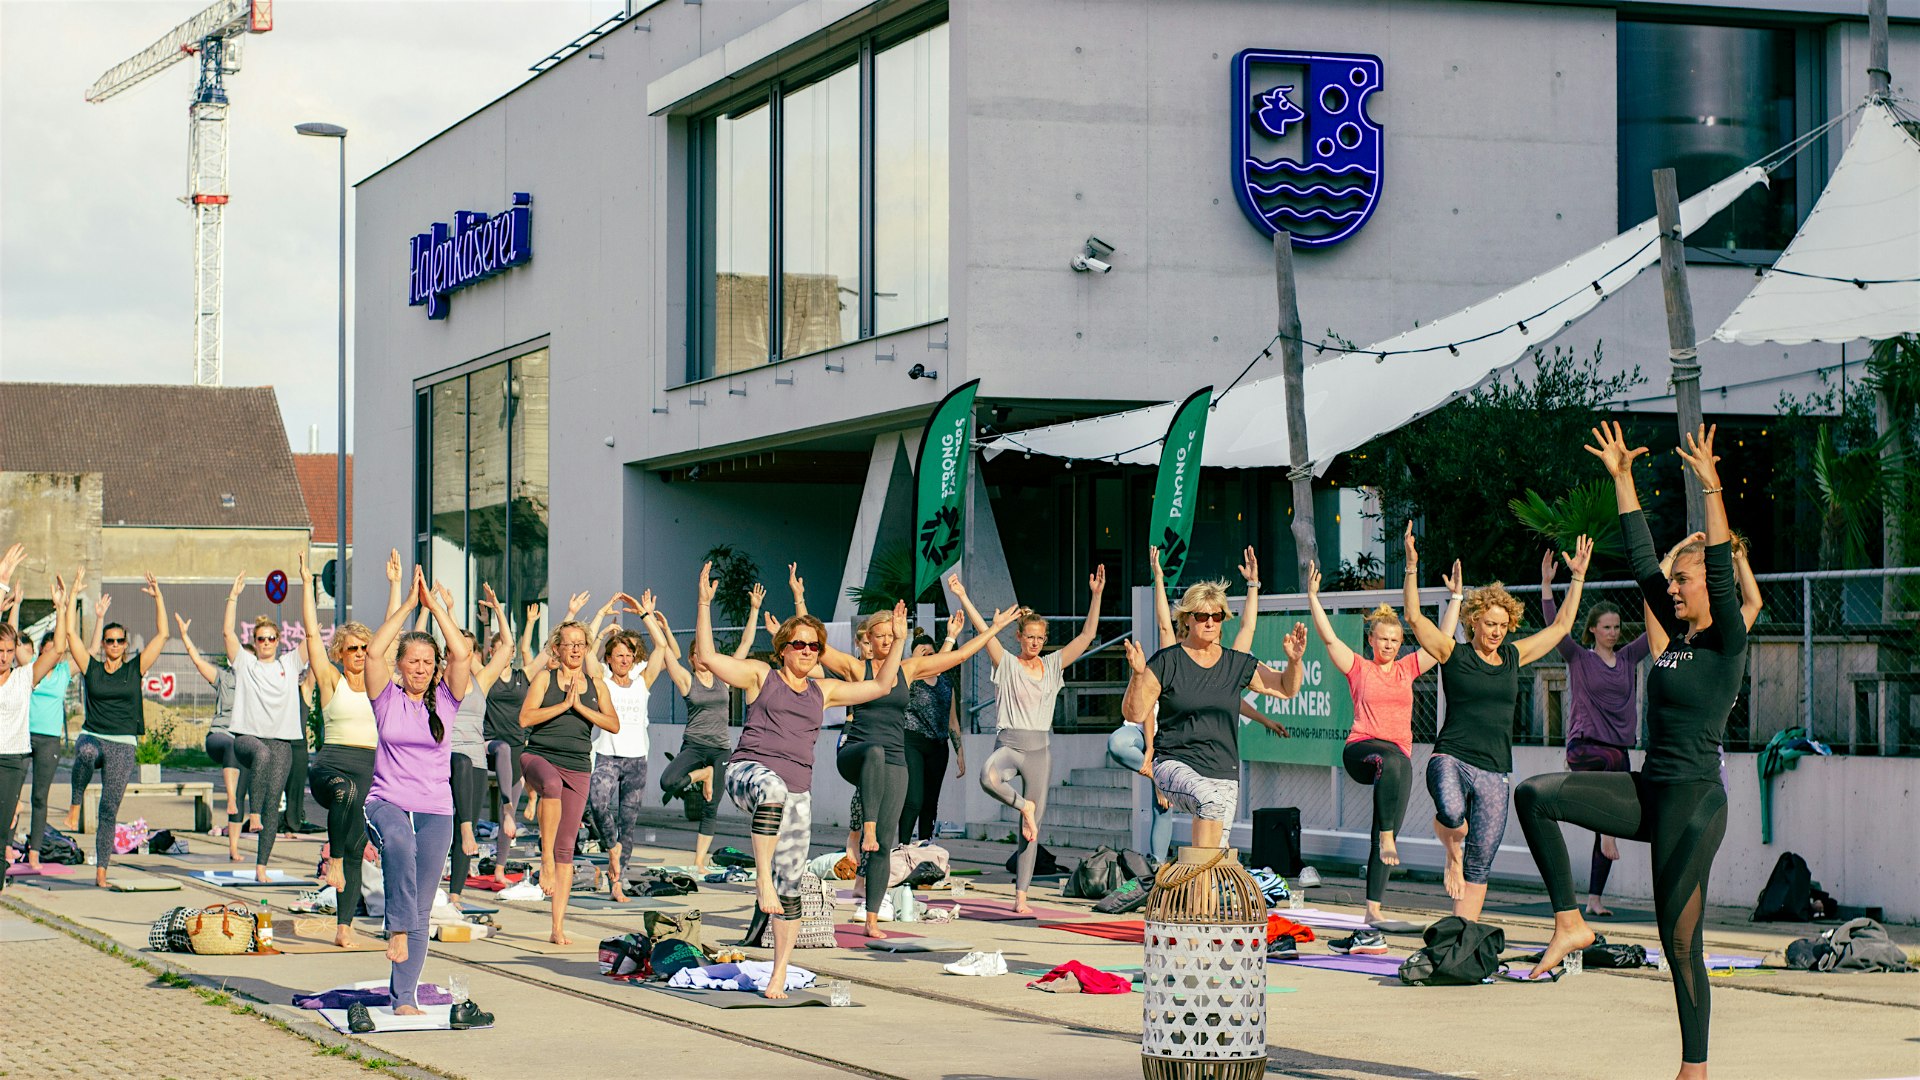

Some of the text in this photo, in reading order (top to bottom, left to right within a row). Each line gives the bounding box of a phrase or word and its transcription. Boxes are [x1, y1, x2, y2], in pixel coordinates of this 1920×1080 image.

[409, 192, 527, 318] Hafenkäserei
[1265, 660, 1322, 686] TNG
[1265, 690, 1331, 716] PARTNERS
[1265, 727, 1352, 740] WTRONG-PARTNERS.D
